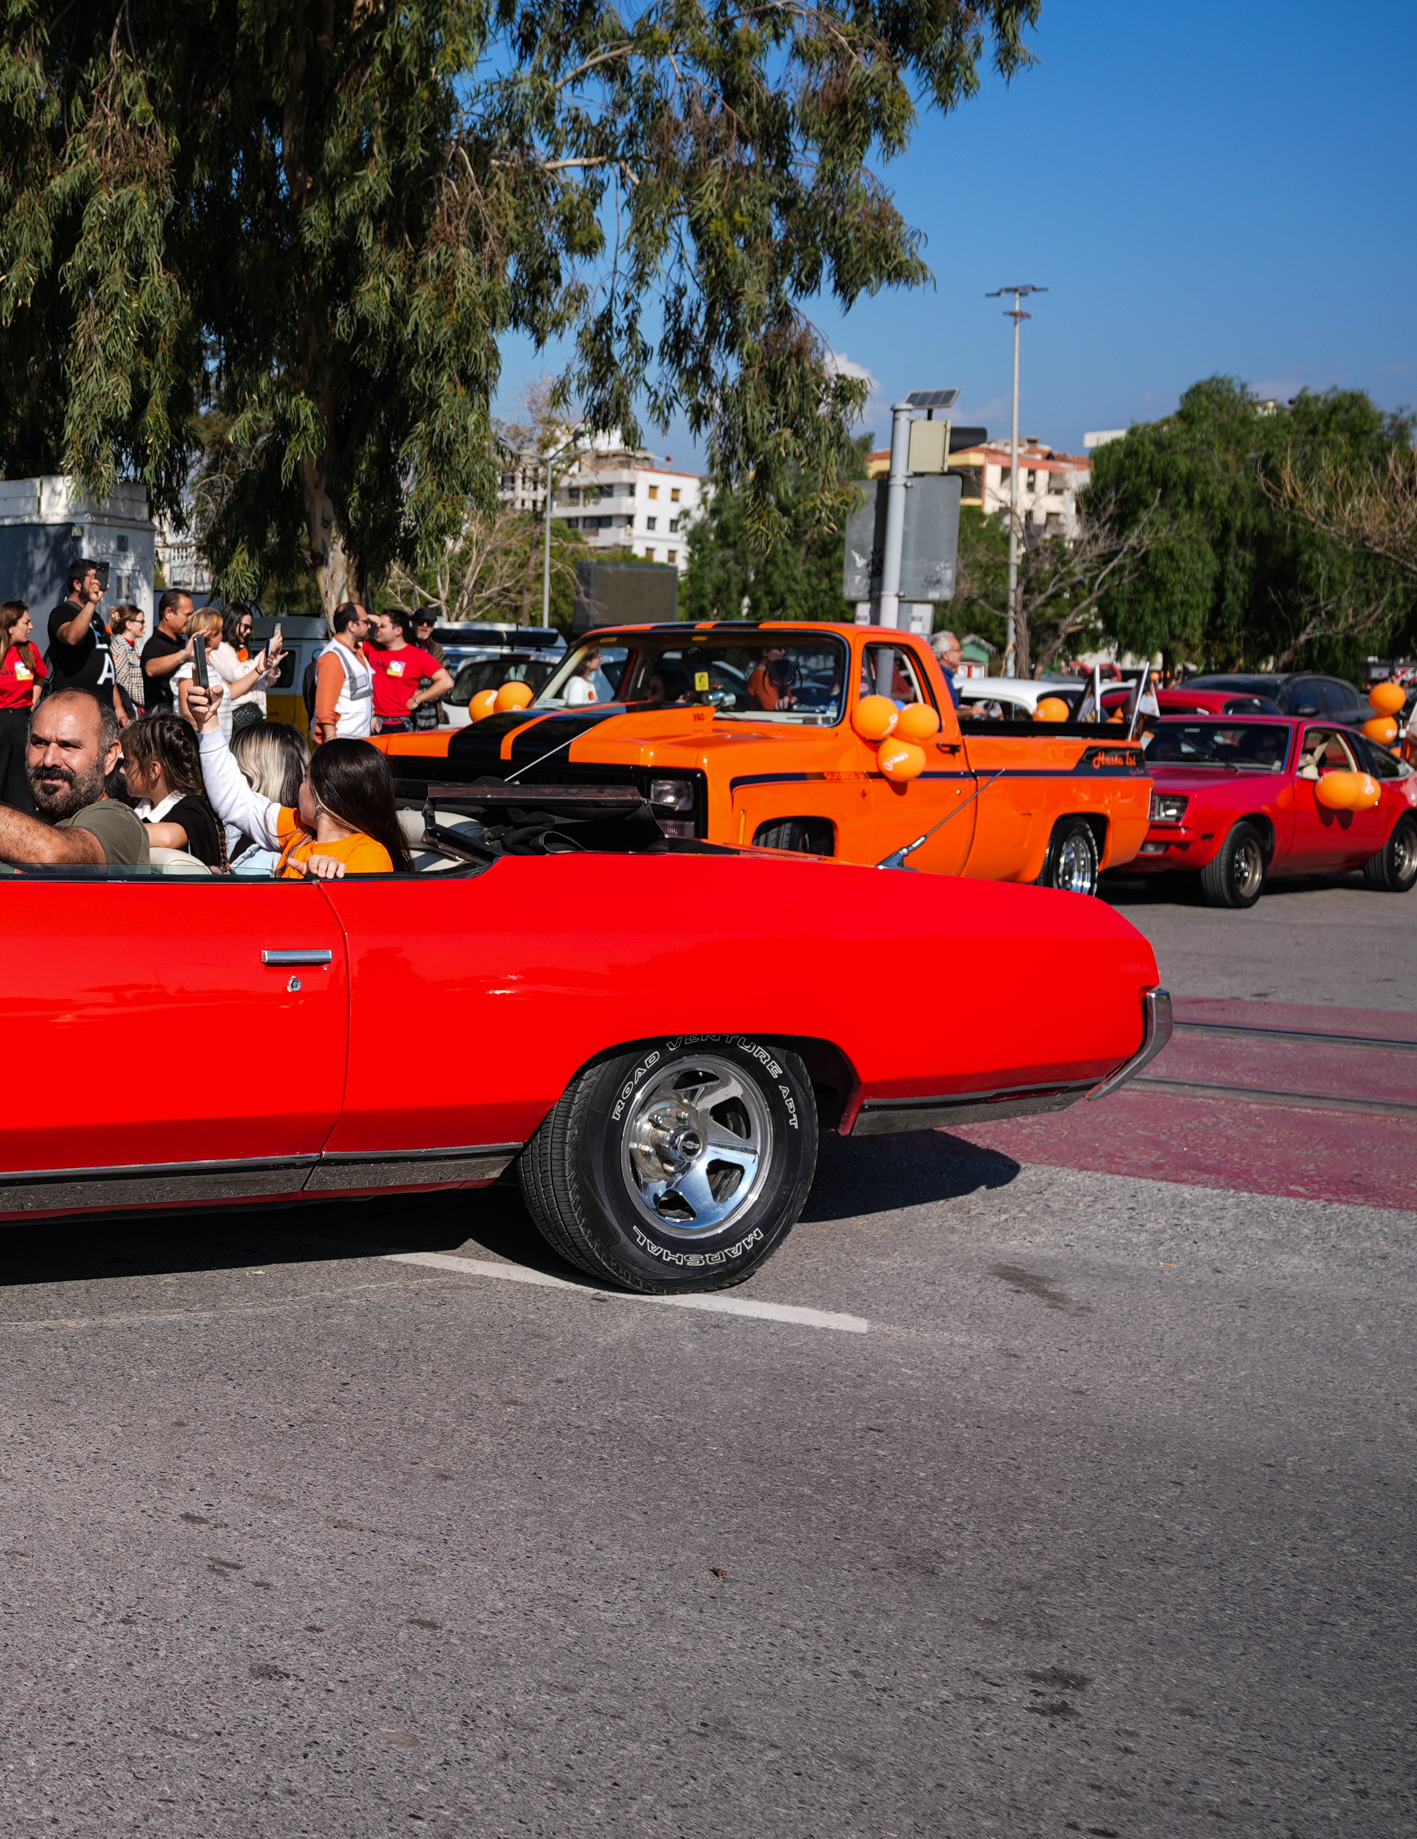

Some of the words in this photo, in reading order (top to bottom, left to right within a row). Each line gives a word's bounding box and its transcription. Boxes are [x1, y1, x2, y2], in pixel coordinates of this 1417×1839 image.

[1092, 750, 1124, 769] Hasta
[612, 1051, 661, 1122] ROAD
[666, 1033, 783, 1080] VENTURE
[778, 1084, 799, 1130] APT
[632, 1225, 765, 1267] MARSHAL
